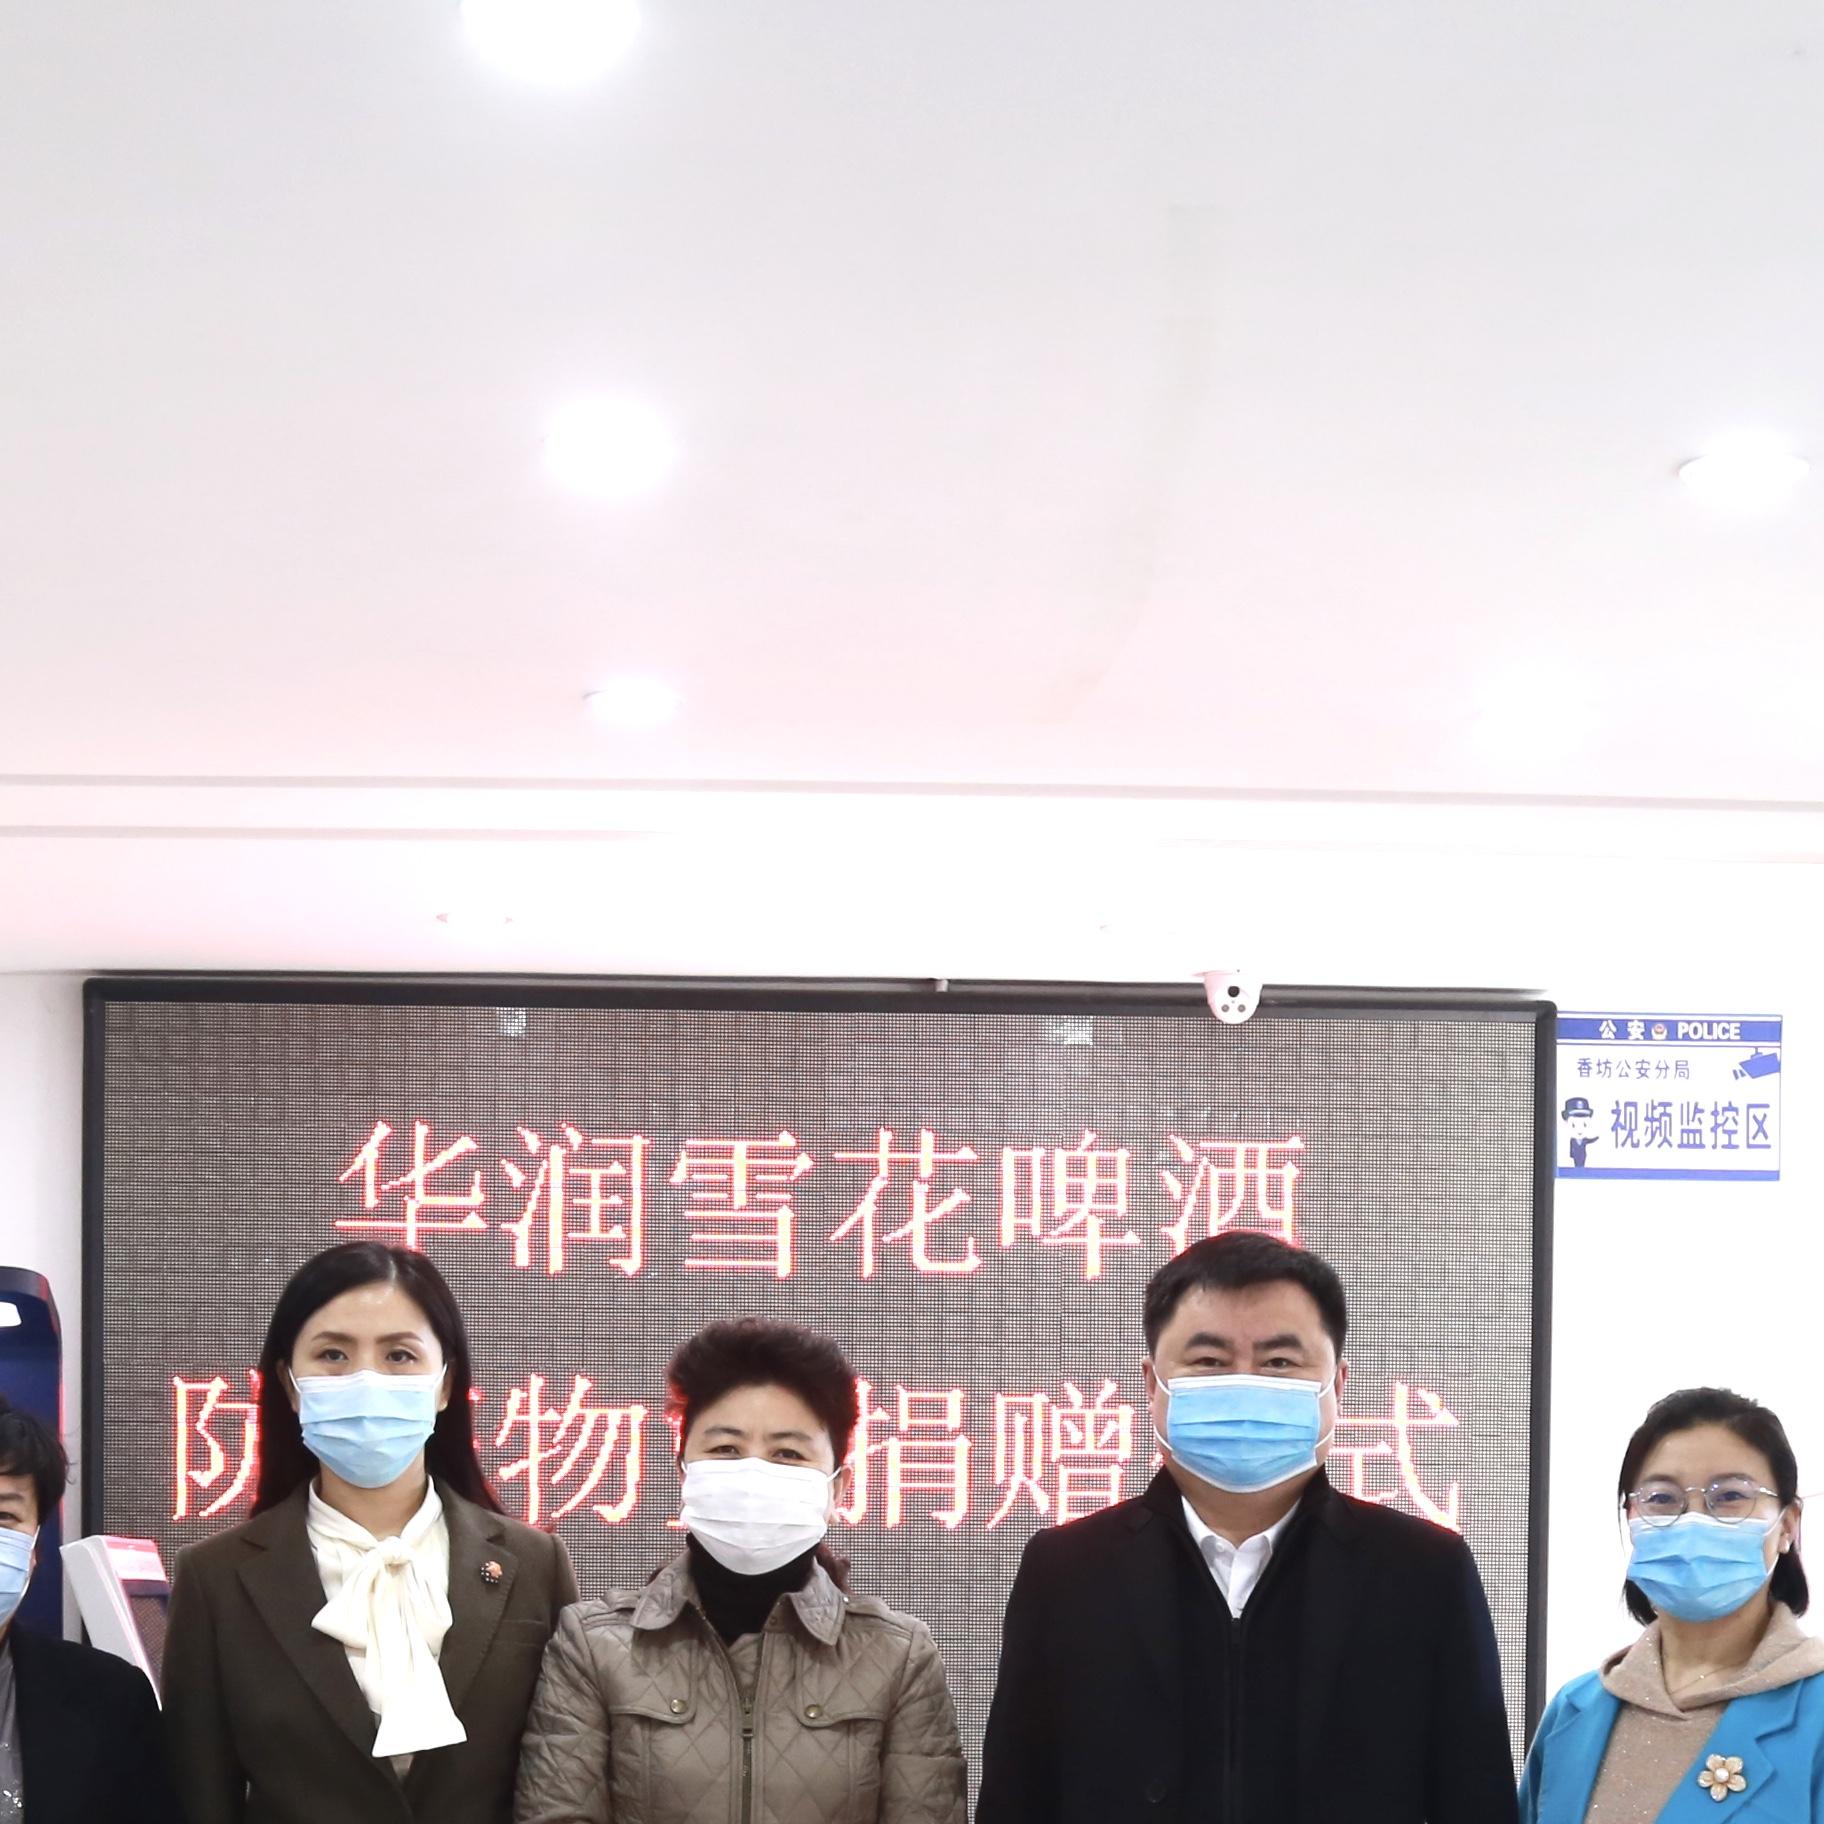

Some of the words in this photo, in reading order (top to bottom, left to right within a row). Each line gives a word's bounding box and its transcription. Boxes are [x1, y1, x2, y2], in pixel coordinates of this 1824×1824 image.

[1599, 1019, 1646, 1040] 公安
[1677, 1021, 1742, 1041] POLICE
[1576, 1057, 1691, 1081] 香坊公安分局
[1610, 1098, 1773, 1150] 视频监控区
[335, 1119, 1306, 1284] 华润雪花啤酒
